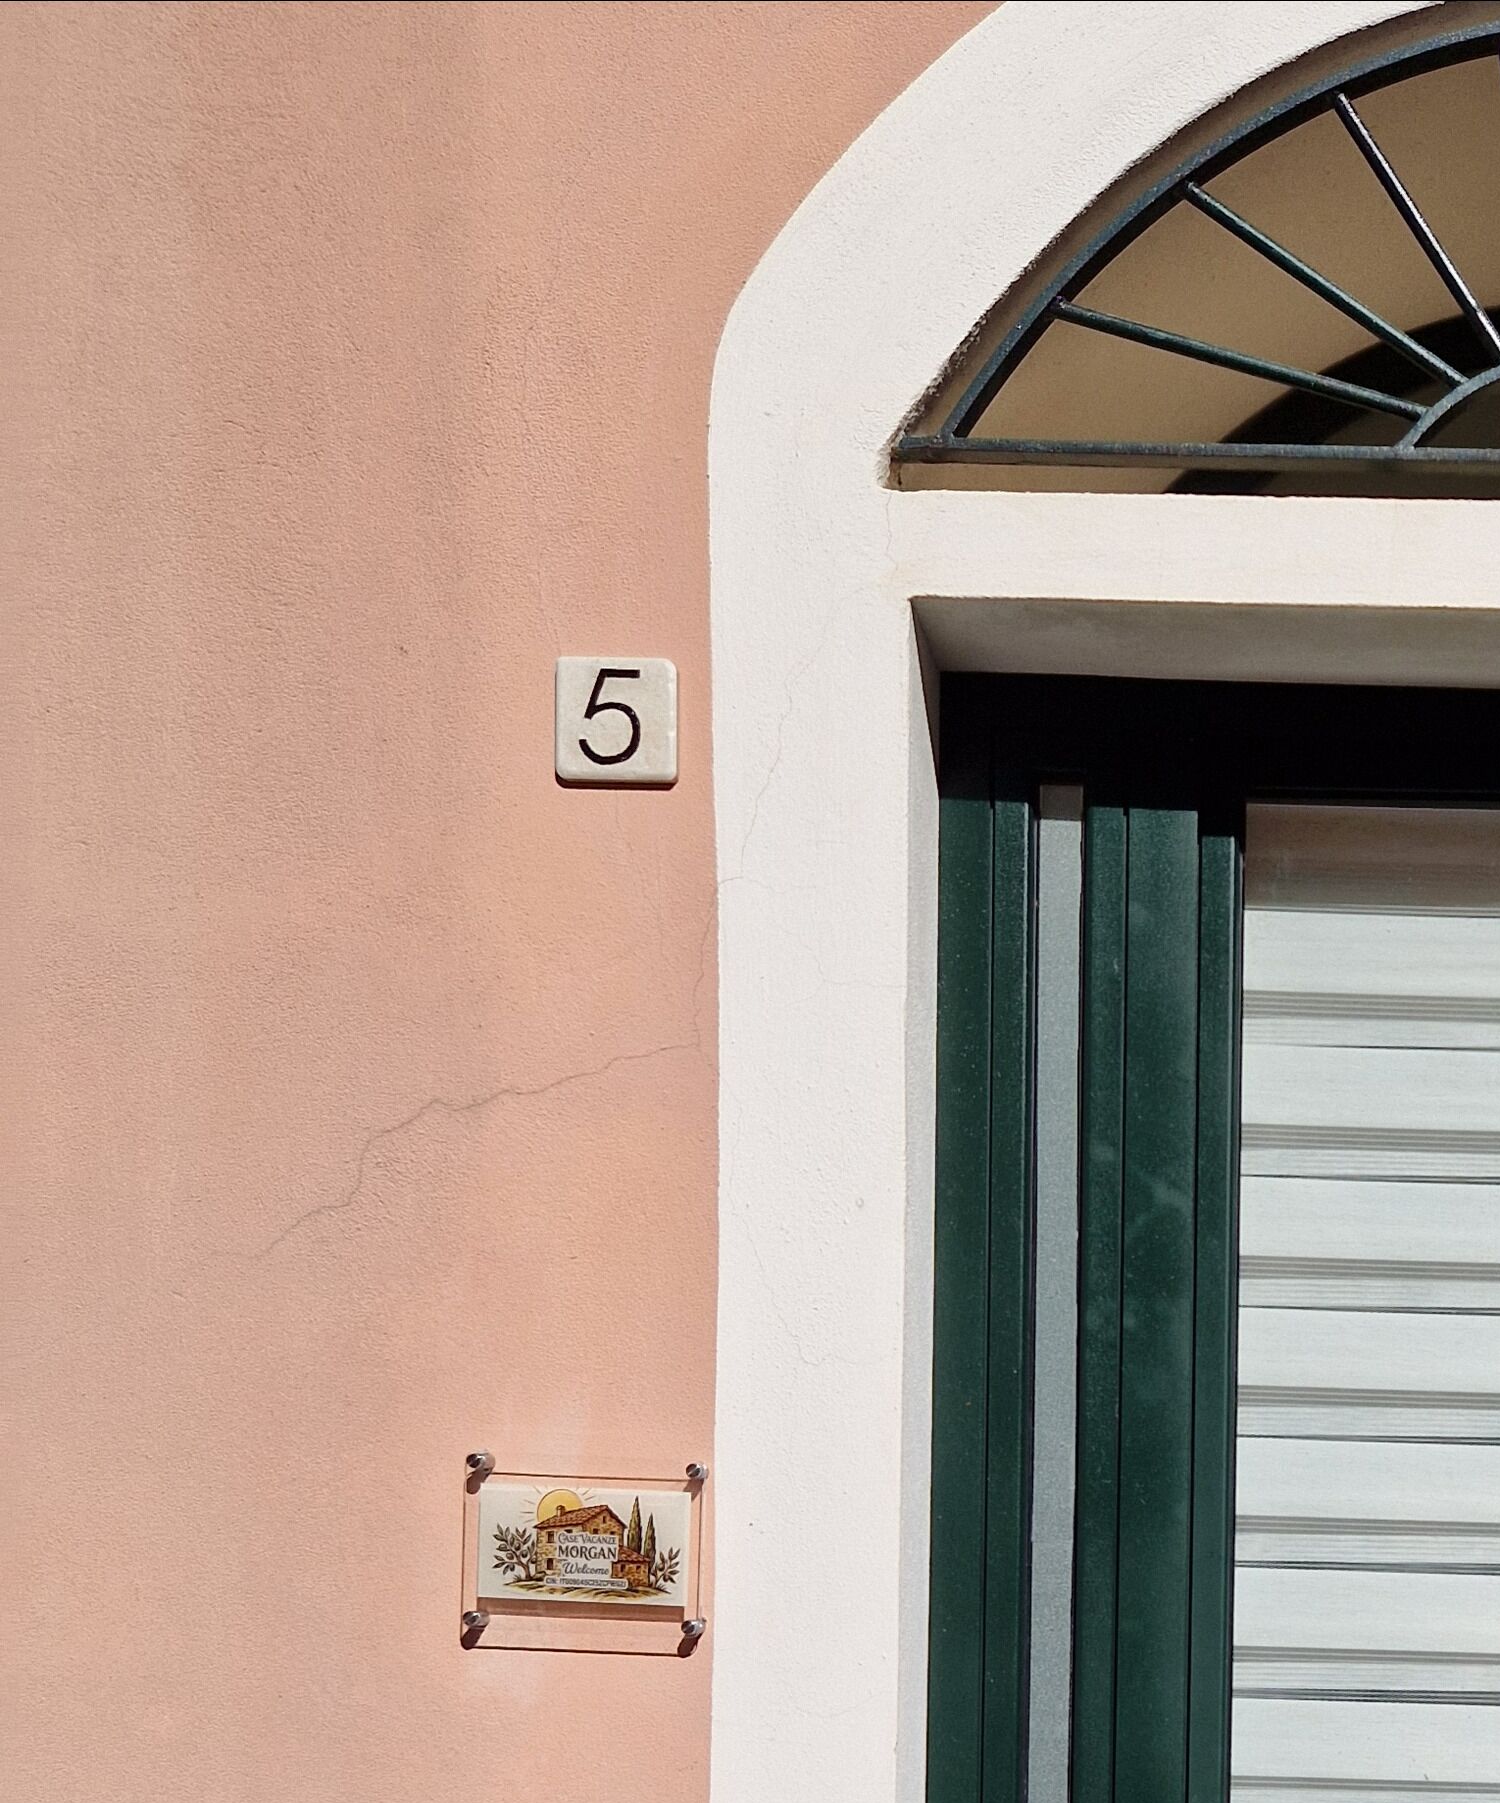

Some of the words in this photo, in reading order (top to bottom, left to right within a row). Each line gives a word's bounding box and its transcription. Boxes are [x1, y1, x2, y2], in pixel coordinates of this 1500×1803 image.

[578, 668, 641, 765] 5
[558, 1545, 617, 1561] MORGAN
[562, 1562, 609, 1575] Welcome
